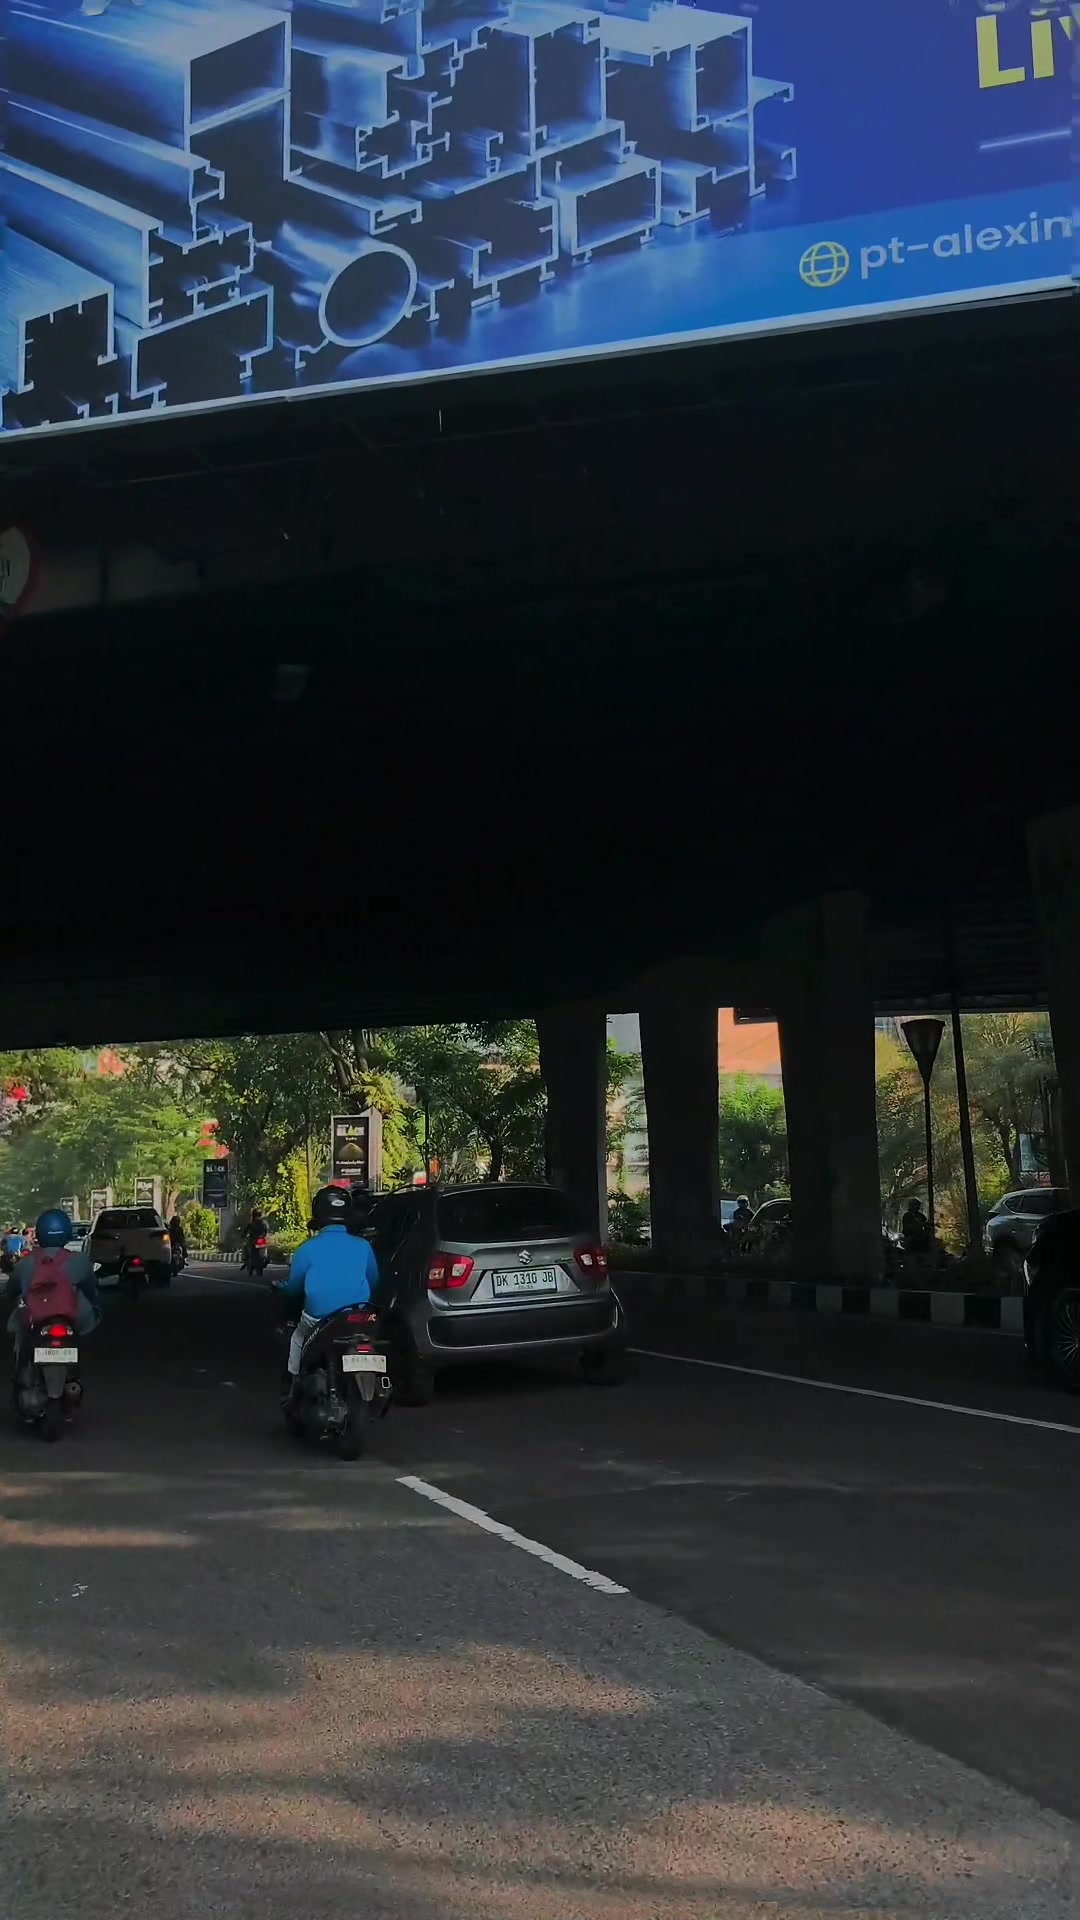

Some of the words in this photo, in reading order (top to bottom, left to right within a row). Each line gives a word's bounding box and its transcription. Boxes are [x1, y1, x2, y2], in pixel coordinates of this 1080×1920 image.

[496, 1275, 508, 1286] DK
[513, 1272, 537, 1285] 1310
[542, 1271, 554, 1282] JB
